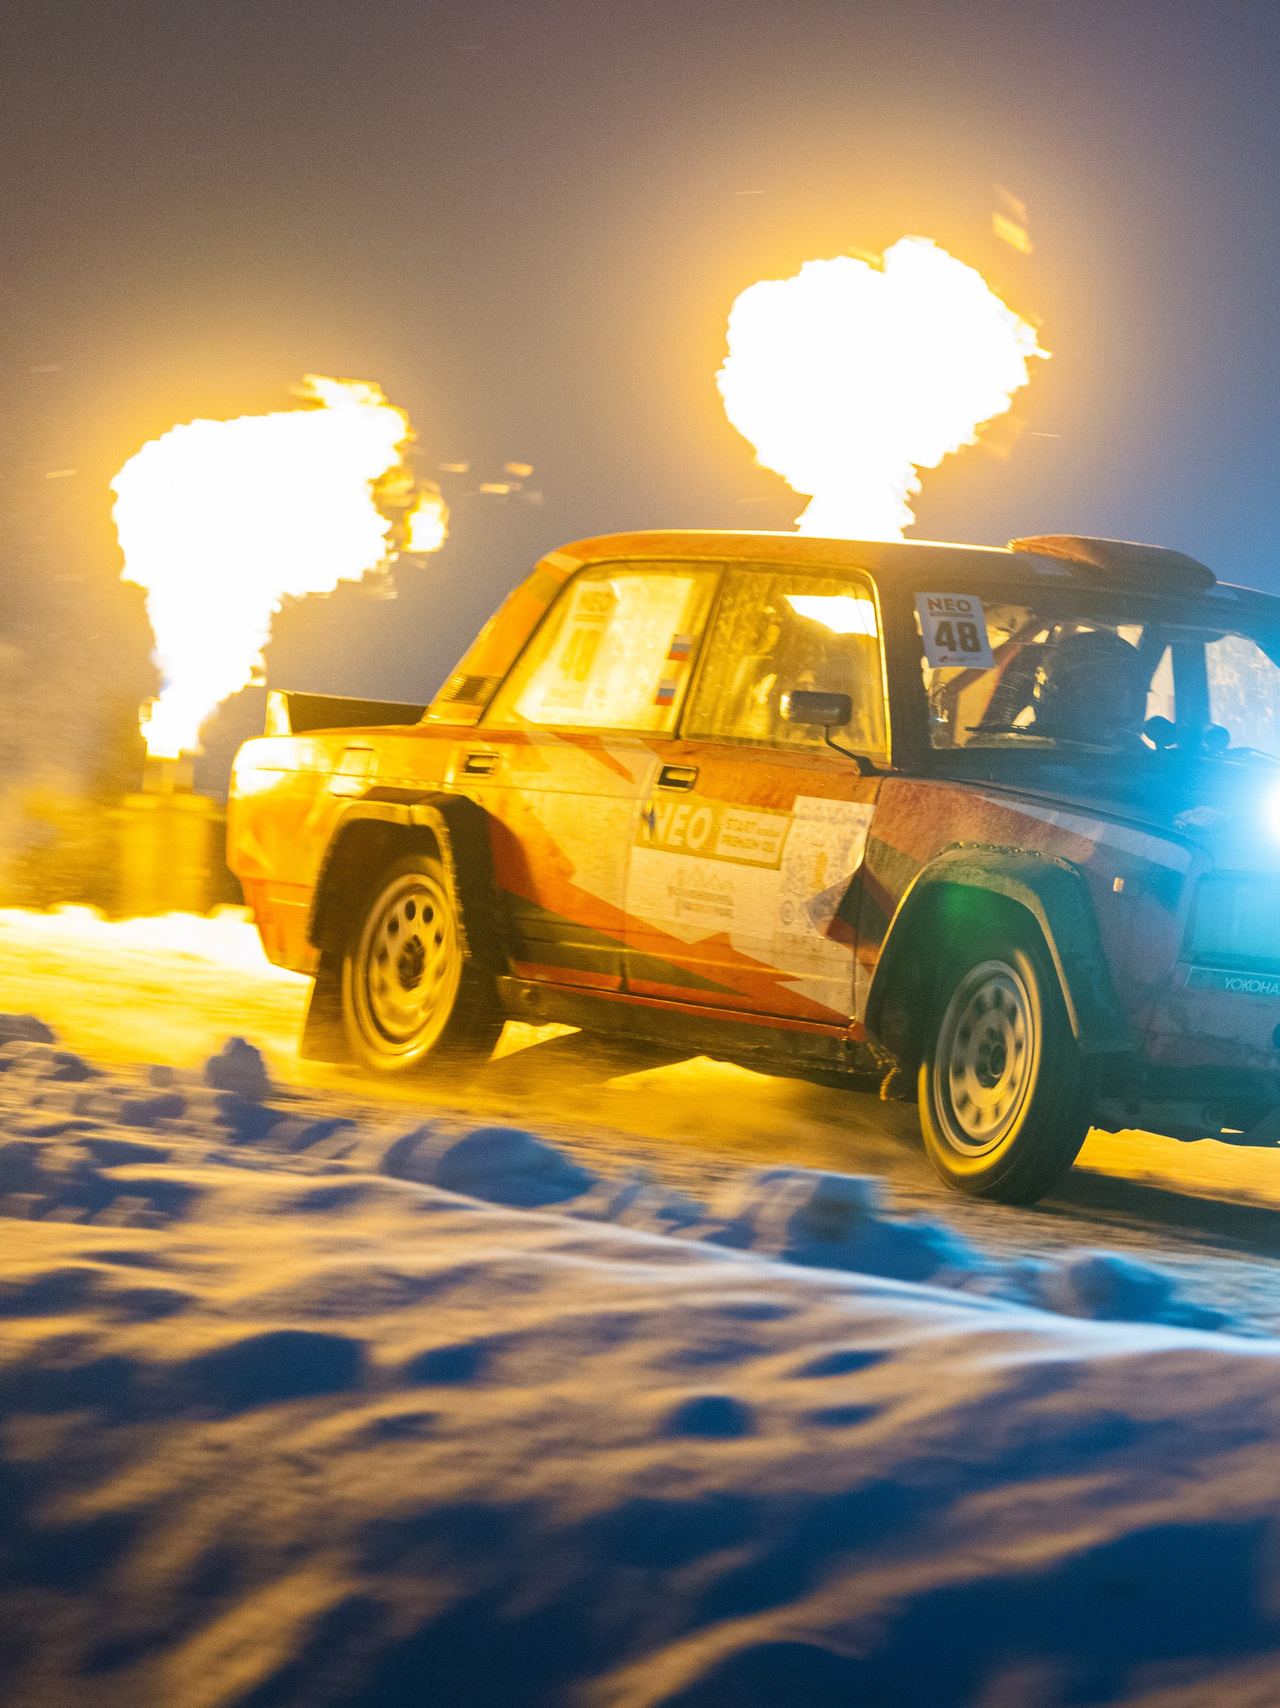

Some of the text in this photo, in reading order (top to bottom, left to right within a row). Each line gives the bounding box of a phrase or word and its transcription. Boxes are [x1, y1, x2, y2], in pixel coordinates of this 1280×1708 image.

[926, 597, 973, 613] NEO
[934, 620, 982, 653] 48
[642, 802, 713, 849] NEO
